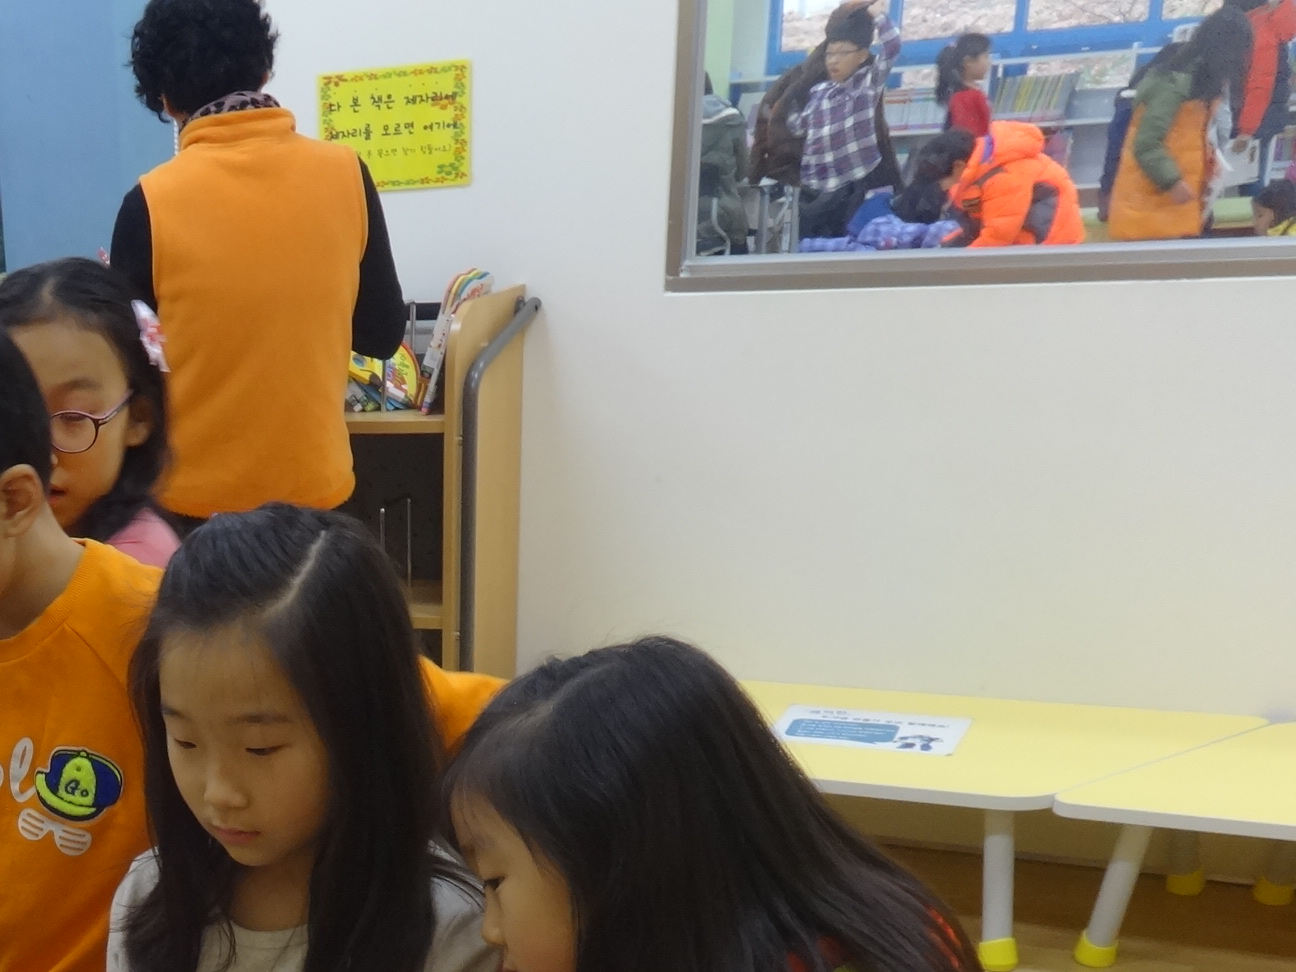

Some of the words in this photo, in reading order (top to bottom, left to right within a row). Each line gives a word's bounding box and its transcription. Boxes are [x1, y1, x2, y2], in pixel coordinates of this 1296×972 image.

[329, 101, 341, 112] 다
[350, 94, 361, 113] 본
[370, 93, 395, 111] 책은
[381, 121, 414, 137] 모르면
